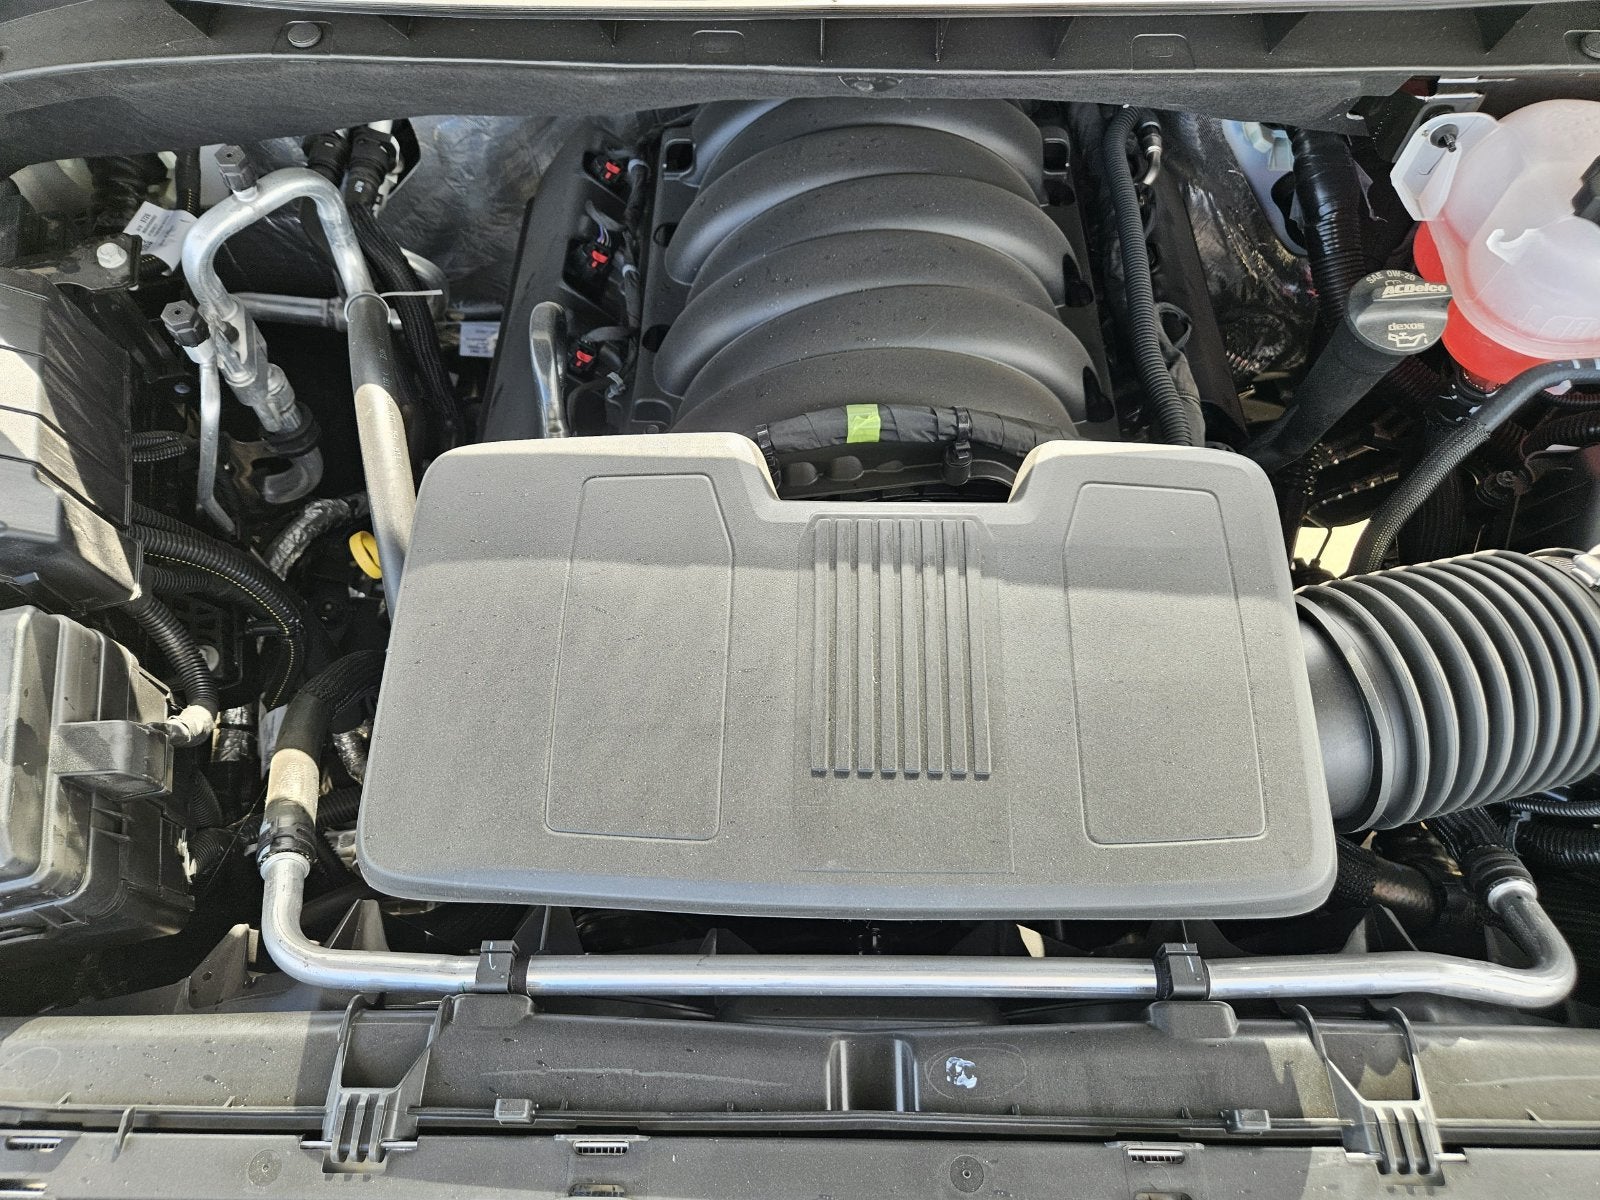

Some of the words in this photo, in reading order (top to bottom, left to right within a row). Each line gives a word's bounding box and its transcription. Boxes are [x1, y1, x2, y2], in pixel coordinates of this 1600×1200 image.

[1366, 272, 1384, 284] SAE
[1386, 270, 1416, 281] 0W-20
[1382, 283, 1447, 296] ACDelco
[1388, 322, 1425, 331] dexos
